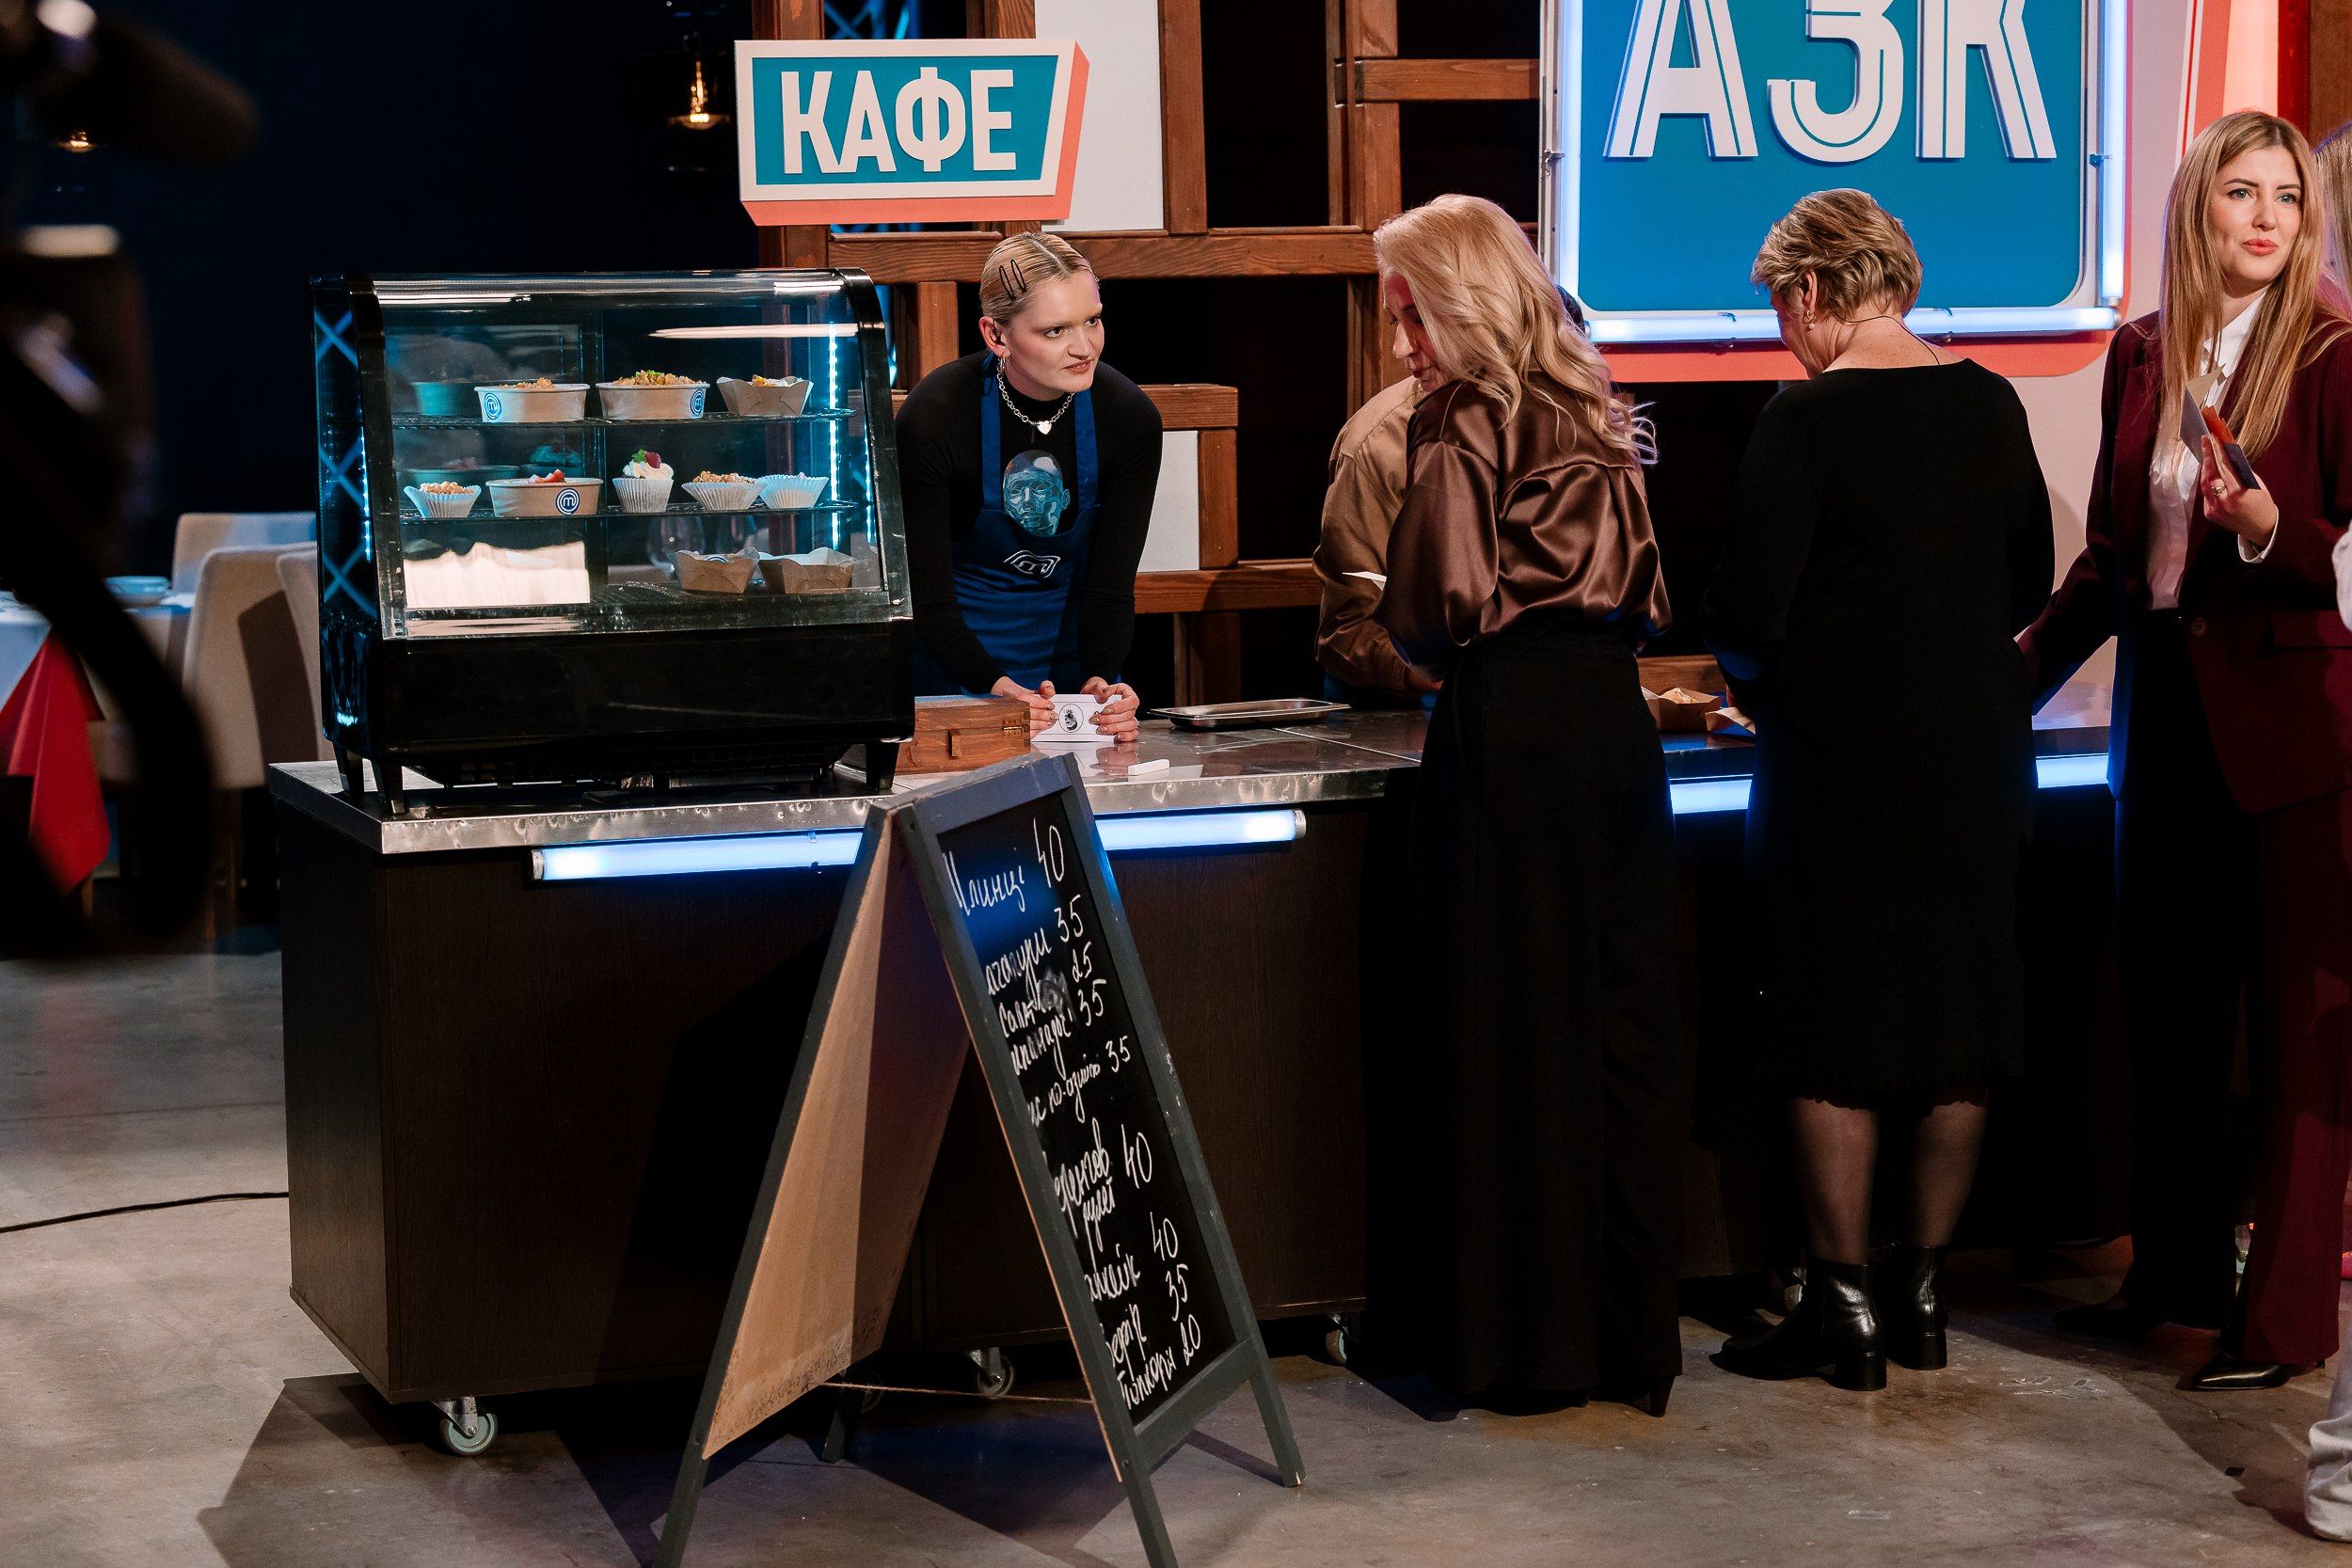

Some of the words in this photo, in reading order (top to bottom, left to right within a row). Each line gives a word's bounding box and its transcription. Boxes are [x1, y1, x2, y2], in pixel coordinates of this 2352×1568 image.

[781, 67, 1017, 174] КАФЕ
[1033, 818, 1065, 888] 40
[1054, 894, 1083, 942] 35
[1073, 942, 1092, 982] 25
[1078, 979, 1106, 1026] 35
[1105, 1036, 1130, 1073] 35
[1121, 1124, 1152, 1189] 40
[1151, 1212, 1178, 1260] 40
[1166, 1263, 1188, 1322] 35
[1180, 1314, 1200, 1366] 20
